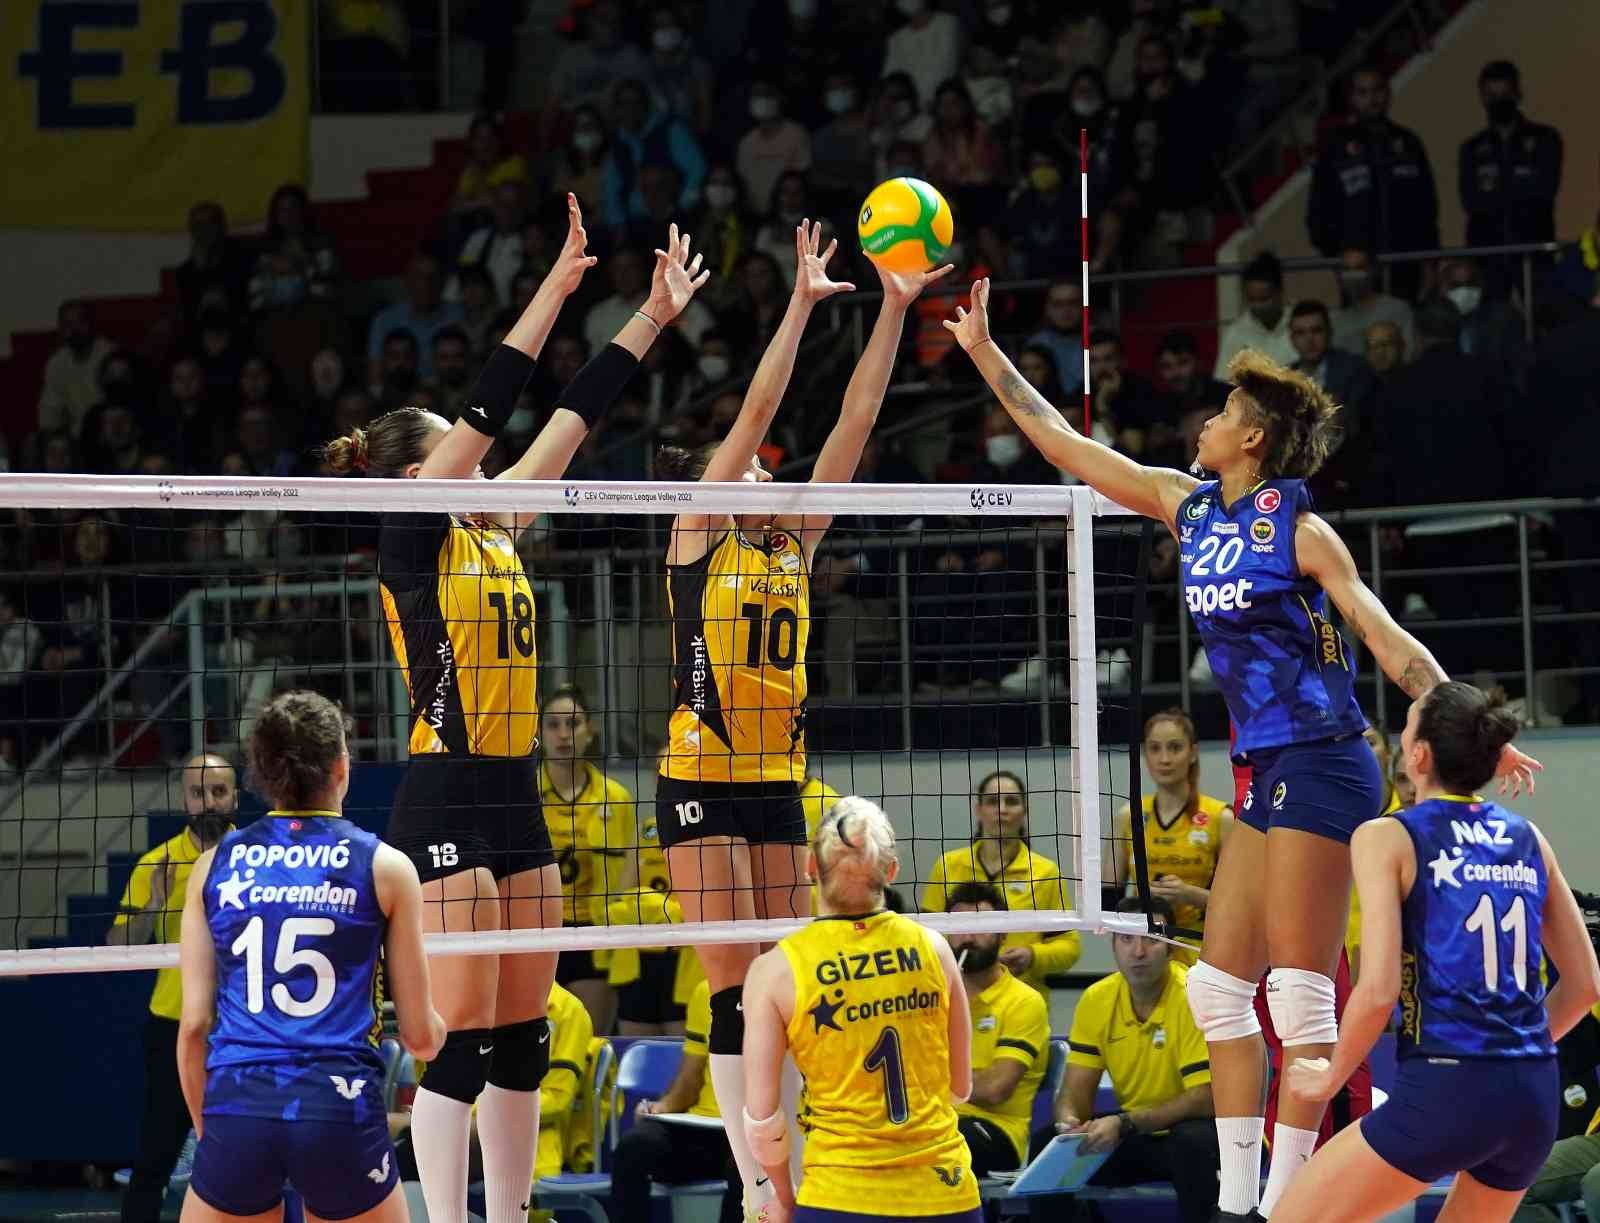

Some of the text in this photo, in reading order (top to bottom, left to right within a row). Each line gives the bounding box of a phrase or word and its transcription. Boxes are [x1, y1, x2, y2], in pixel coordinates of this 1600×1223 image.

[235, 488, 260, 499] League
[584, 492, 598, 500] CEV
[599, 492, 633, 502] Champions
[635, 492, 656, 502] League
[988, 492, 1012, 506] CEV
[1191, 535, 1245, 576] 20
[488, 592, 534, 659] 18
[742, 602, 798, 671] 10
[675, 801, 703, 827] 10
[1451, 820, 1513, 845] NAZ
[229, 839, 350, 869] POPOVIĆ
[428, 842, 459, 868] 18
[1463, 860, 1538, 886] corendon
[249, 881, 358, 905] corendon
[298, 903, 355, 914] AIRLINES
[1465, 894, 1528, 992] 11
[231, 916, 336, 1017] 15
[846, 988, 940, 1022] corendon
[864, 1026, 909, 1125] 1
